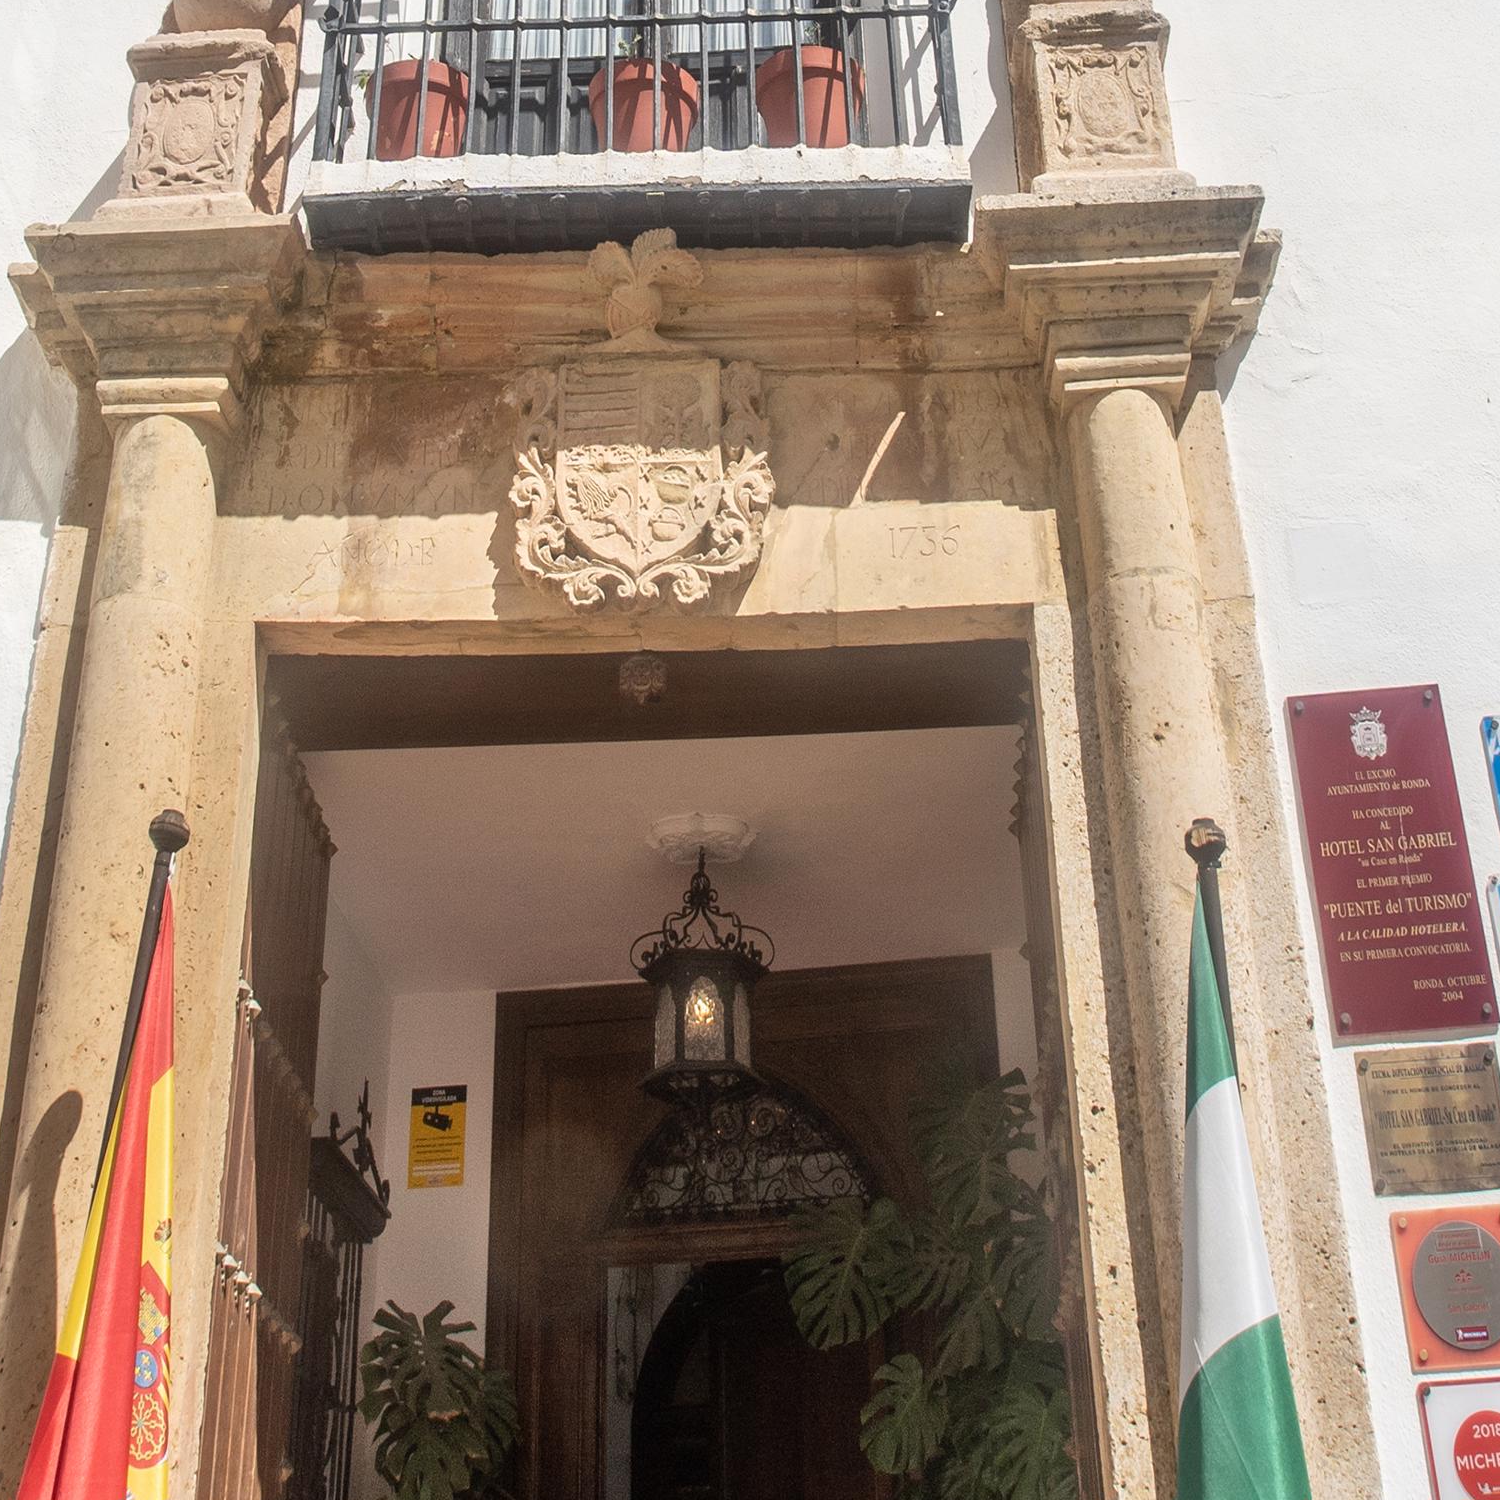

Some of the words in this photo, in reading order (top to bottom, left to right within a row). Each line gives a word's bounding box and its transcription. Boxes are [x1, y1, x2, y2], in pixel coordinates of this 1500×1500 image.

[1355, 771, 1364, 781] EL
[1366, 768, 1396, 781] EXCMO
[1327, 781, 1390, 796] AYUNTAMIENTO
[1392, 780, 1400, 790] de
[1401, 779, 1431, 790] RONDA
[1352, 809, 1364, 820] HA
[1365, 805, 1414, 818] CONCEDIDO
[1380, 820, 1390, 830] AL
[1320, 839, 1365, 857] HOTEL
[1367, 836, 1395, 853] SAN
[1398, 831, 1457, 850] GABRIEL
[1371, 856, 1387, 867] Casa
[1389, 856, 1397, 866] en
[1356, 879, 1366, 889] EL
[1368, 875, 1399, 888] PRIMER
[1401, 873, 1433, 887] PREMIO
[1324, 900, 1382, 919] "PUENTE
[1385, 900, 1403, 914] del
[1405, 892, 1472, 913] TURISMO"
[1338, 931, 1345, 942] A
[1347, 930, 1360, 941] LA
[1362, 926, 1408, 940] CALIDAD
[1340, 952, 1352, 962] EN
[1353, 950, 1365, 961] SU
[1366, 948, 1403, 961] PRIMERA
[1447, 974, 1487, 988] OCTUBRE
[1442, 991, 1464, 1002] 2004
[1449, 1250, 1493, 1264] MICHELIN
